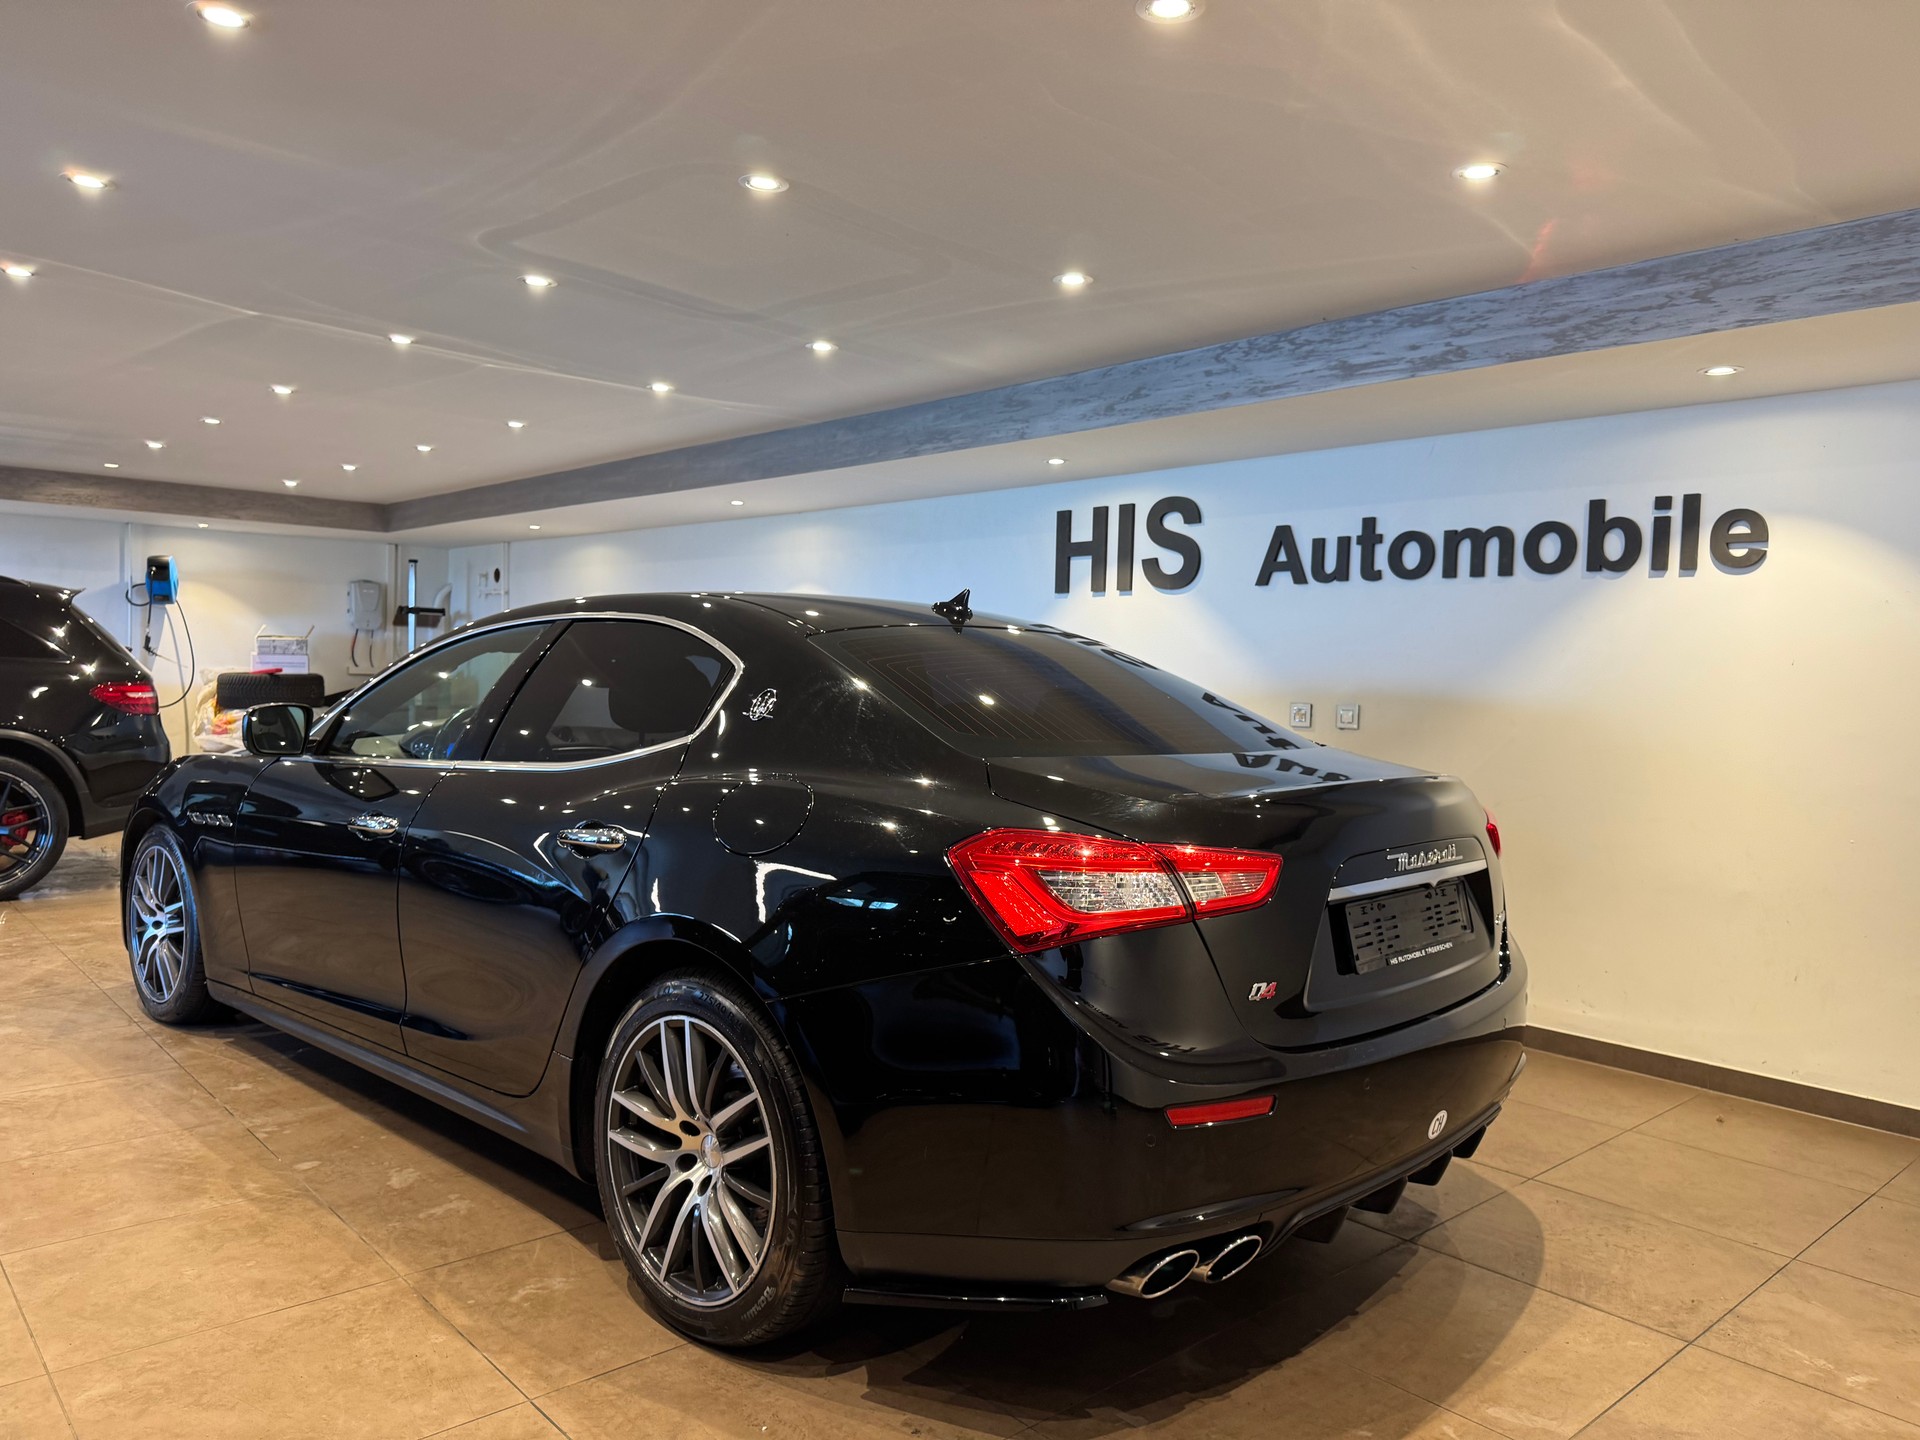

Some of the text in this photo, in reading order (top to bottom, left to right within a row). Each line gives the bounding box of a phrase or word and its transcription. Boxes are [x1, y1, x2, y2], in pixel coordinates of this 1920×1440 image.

[1055, 493, 1770, 594] HIS Automobile
[1387, 843, 1463, 872] Maserati
[1398, 949, 1425, 963] AUTOMOBILE
[1431, 1114, 1445, 1136] CH
